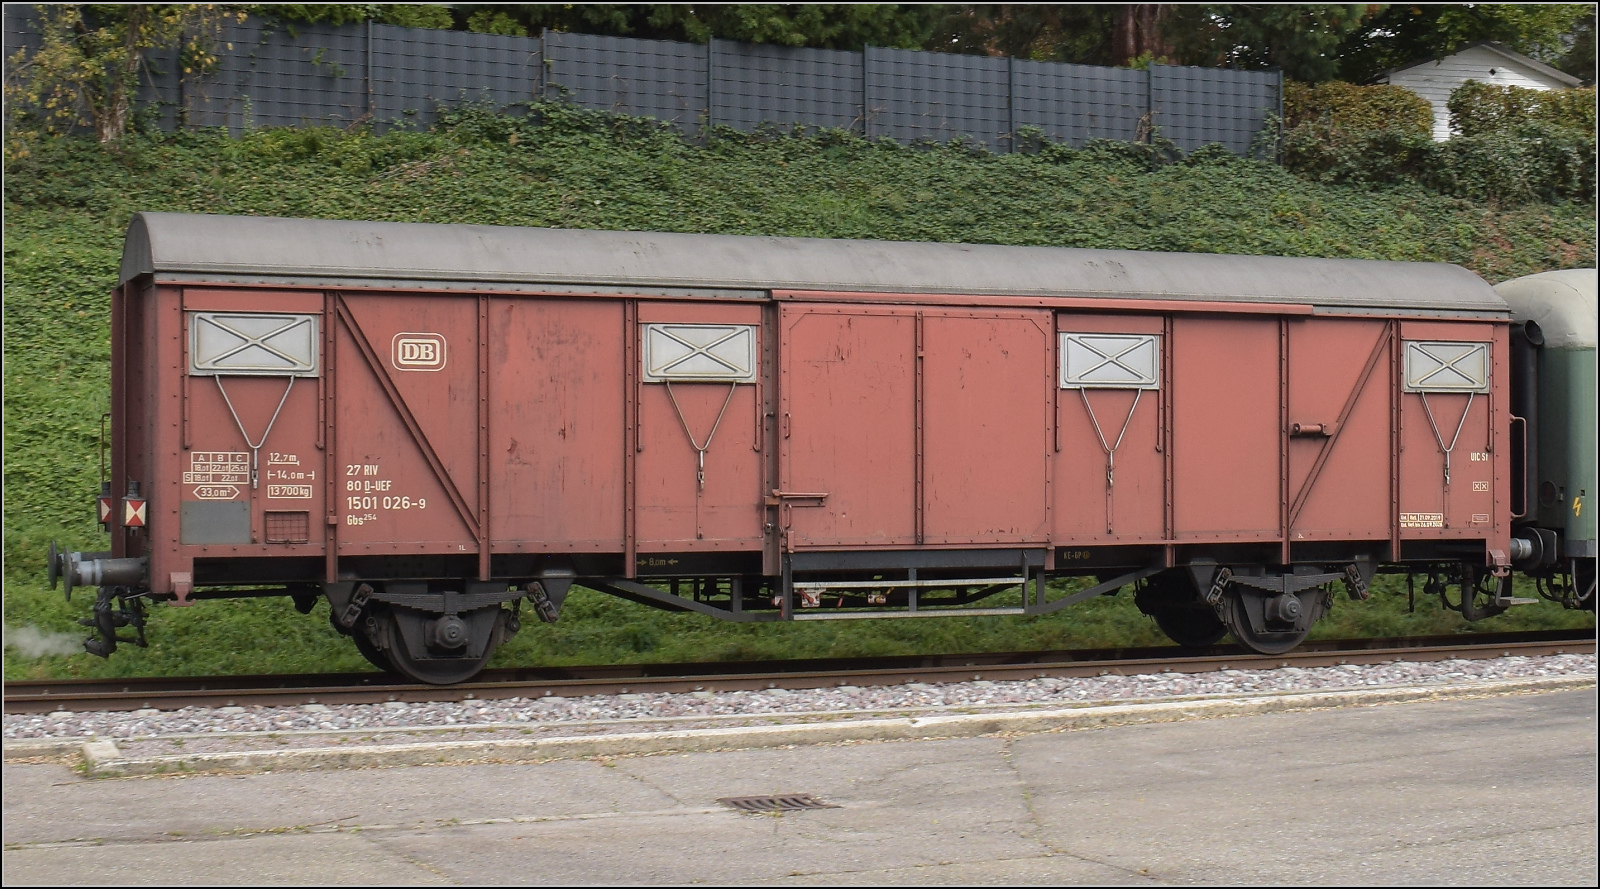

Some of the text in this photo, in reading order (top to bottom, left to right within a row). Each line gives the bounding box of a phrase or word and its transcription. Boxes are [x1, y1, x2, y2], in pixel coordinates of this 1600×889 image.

[402, 343, 434, 360] DB
[198, 454, 242, 462] A B C
[1470, 452, 1481, 462] UIC
[346, 464, 378, 475] 27 RIV
[185, 473, 191, 482] S
[270, 486, 280, 496] 13
[346, 480, 392, 494] 80 D-UEF
[346, 495, 426, 510] 1501 026-9
